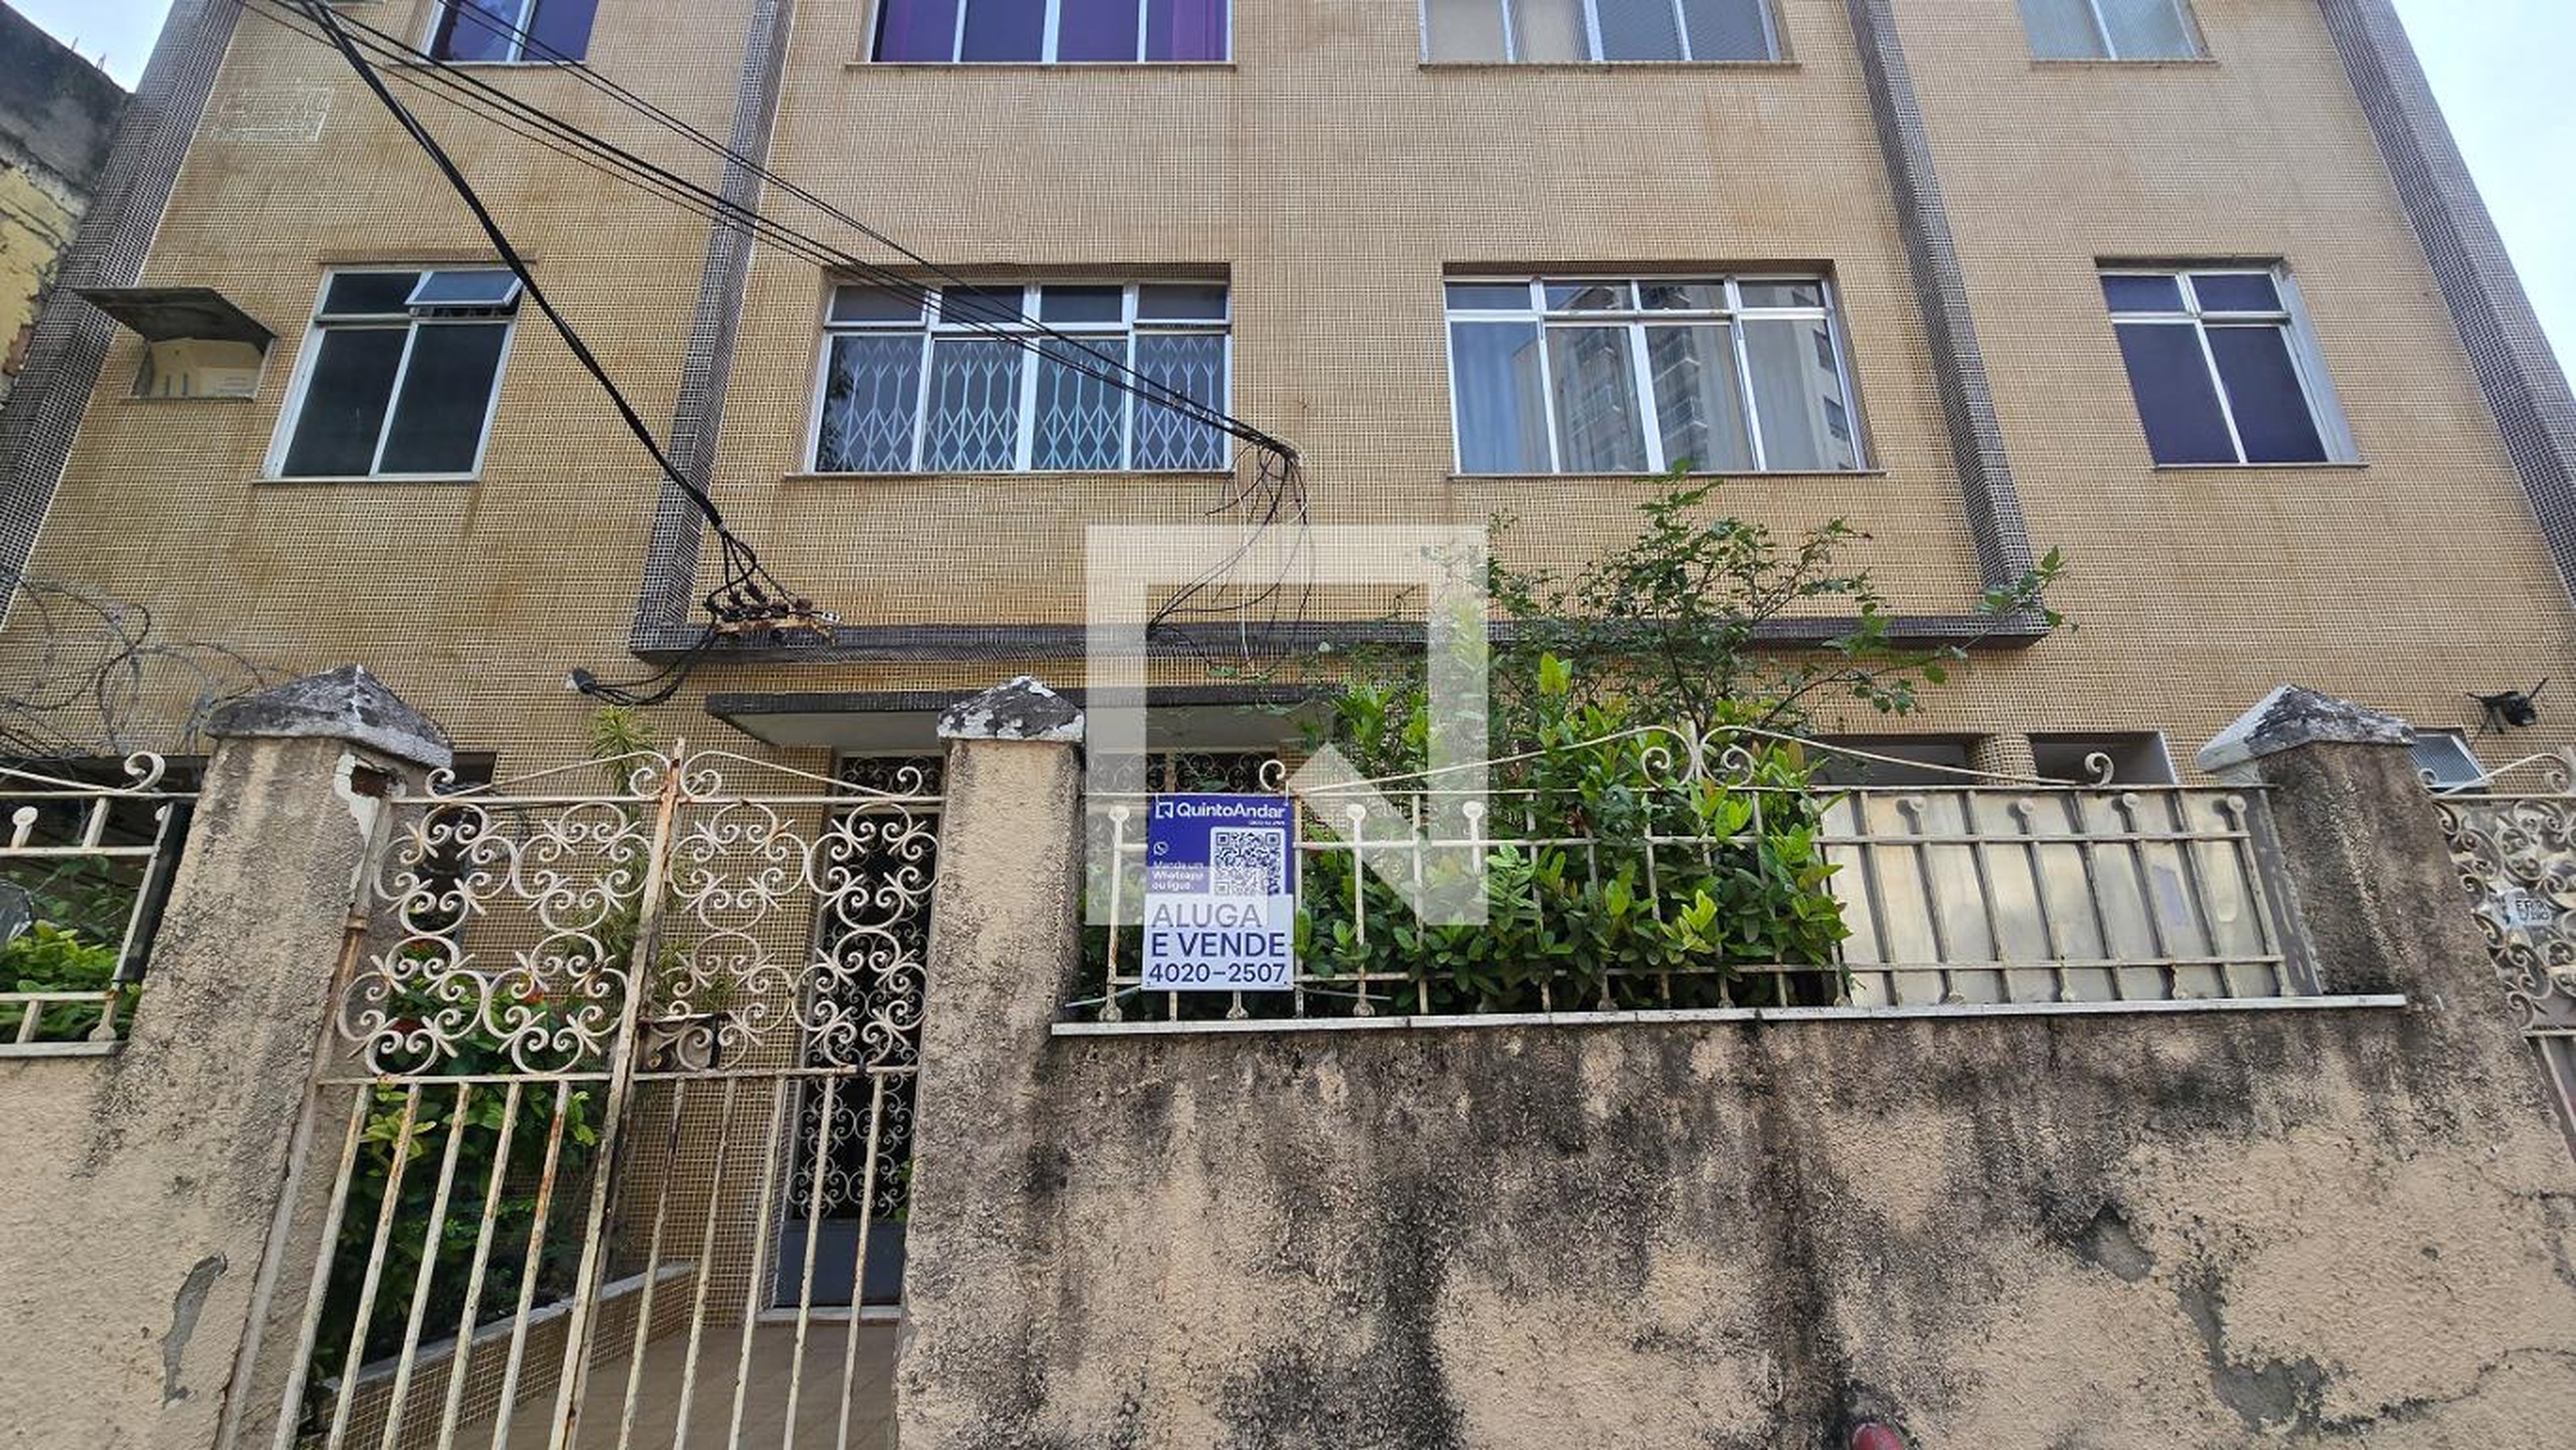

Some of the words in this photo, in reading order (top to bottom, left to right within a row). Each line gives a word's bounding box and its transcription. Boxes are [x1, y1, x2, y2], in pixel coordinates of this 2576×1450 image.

[1177, 802, 1286, 819] QuintoAndar
[1151, 903, 1262, 928] ALUGA
[1152, 932, 1169, 958] E
[1177, 932, 1286, 958] VENDE
[1148, 962, 1286, 983] 4020-2507
